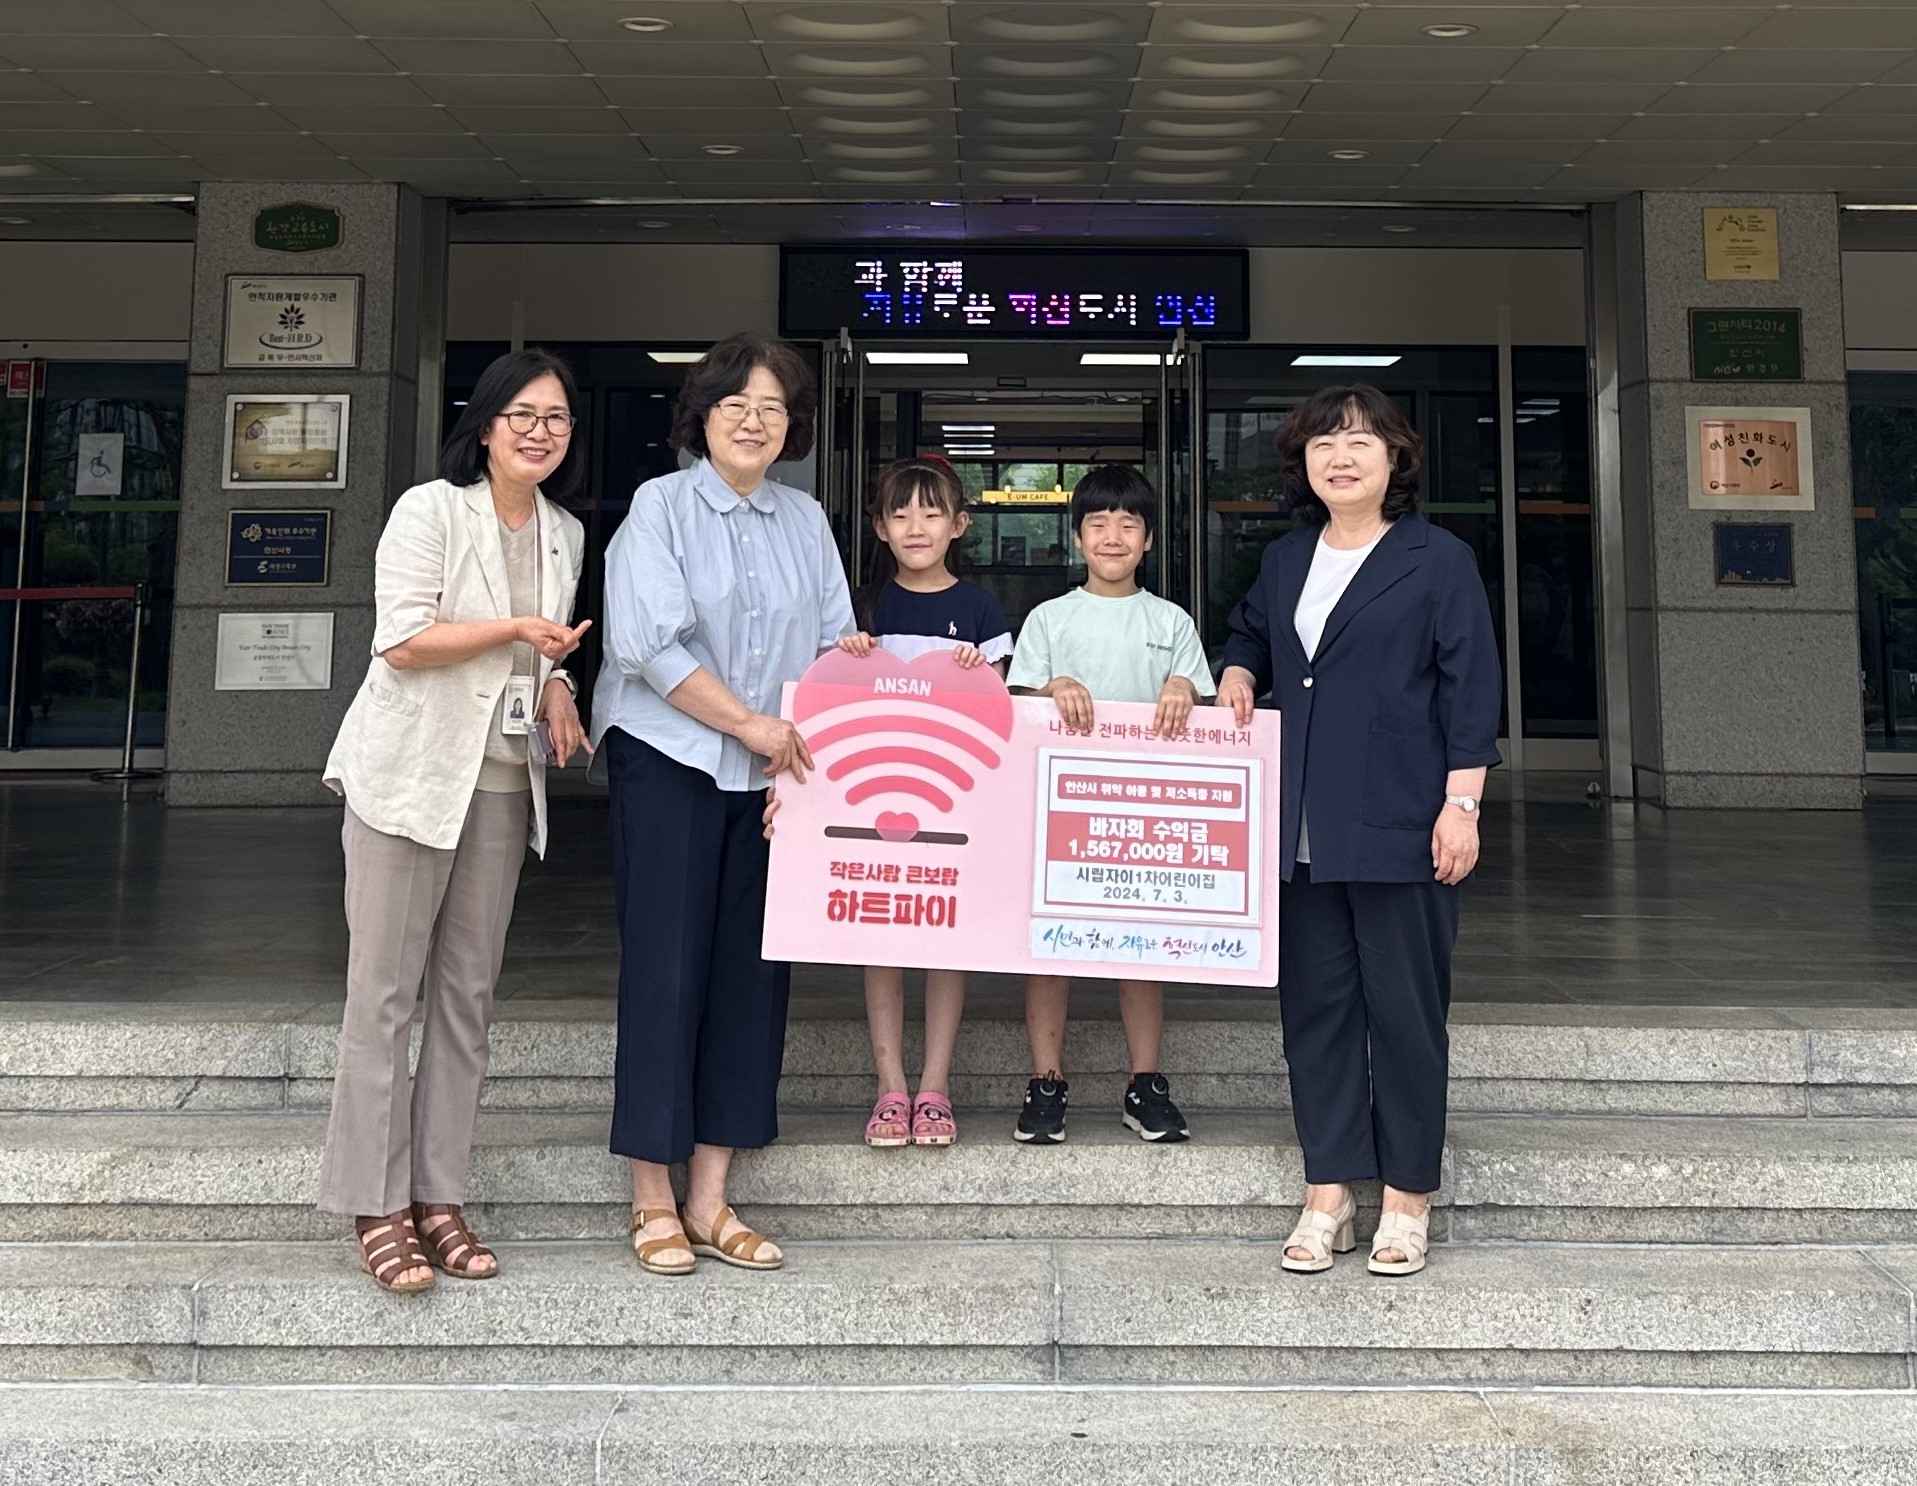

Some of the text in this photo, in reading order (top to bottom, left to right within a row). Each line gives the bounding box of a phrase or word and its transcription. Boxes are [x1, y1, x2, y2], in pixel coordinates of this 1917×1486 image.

[874, 677, 932, 697] ANSAN
[1099, 723, 1156, 740] 전파하는
[1065, 780, 1097, 796] 안산시
[1089, 816, 1208, 844] 바자회 수익금
[1068, 839, 1229, 866] 1,567,000원 기탁
[830, 861, 959, 886] 작은사랑 큰보람
[1076, 867, 1216, 889] 시립자이1차어린이집
[1104, 886, 1188, 904] 2024. 7. 3.
[827, 890, 957, 928] 하트파이
[1043, 924, 1082, 953] 시민과
[1118, 934, 1158, 959] 자유로운
[1162, 935, 1208, 960] 혁신도시
[1211, 939, 1248, 959] 안산
